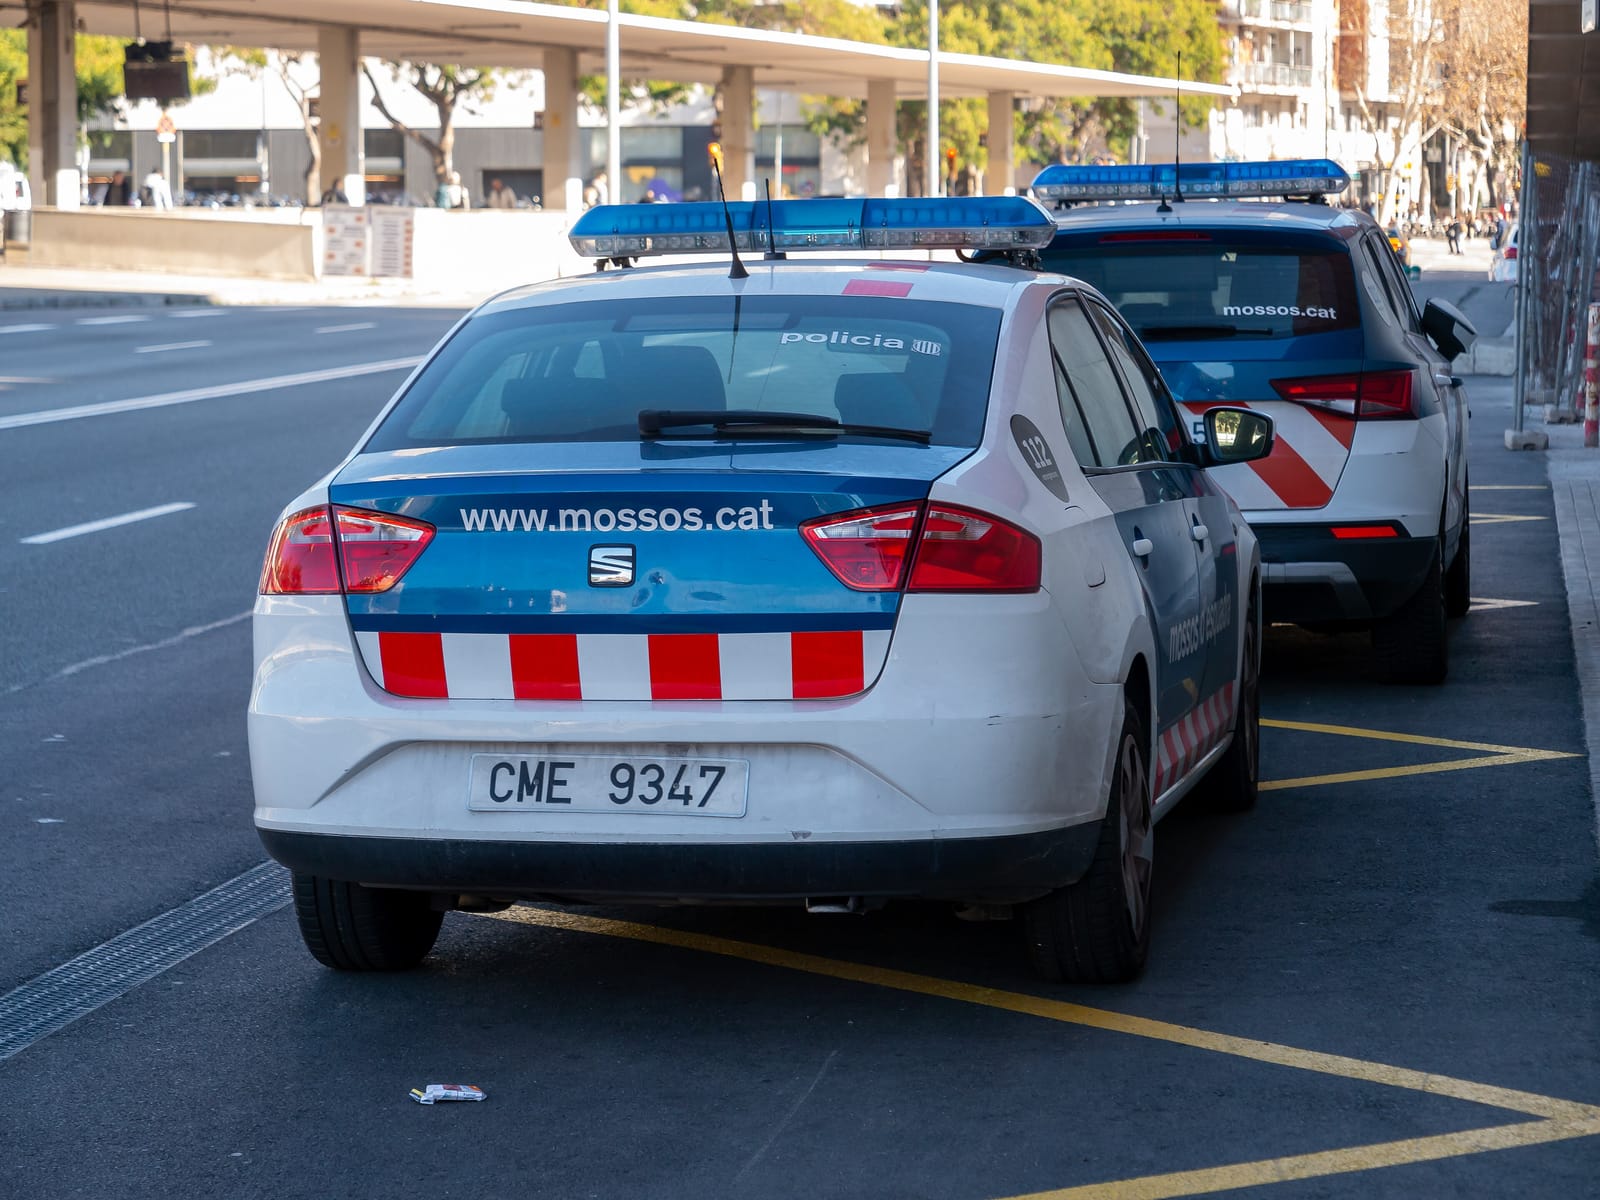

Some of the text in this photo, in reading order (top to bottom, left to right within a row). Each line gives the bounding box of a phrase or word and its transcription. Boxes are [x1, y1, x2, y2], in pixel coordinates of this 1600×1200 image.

[1223, 305, 1337, 320] mossos.cat
[781, 331, 904, 349] policia
[1022, 436, 1052, 469] 112
[459, 499, 774, 532] www.mossos.cat
[1169, 614, 1199, 664] mossos
[489, 761, 726, 808] CME 9347
